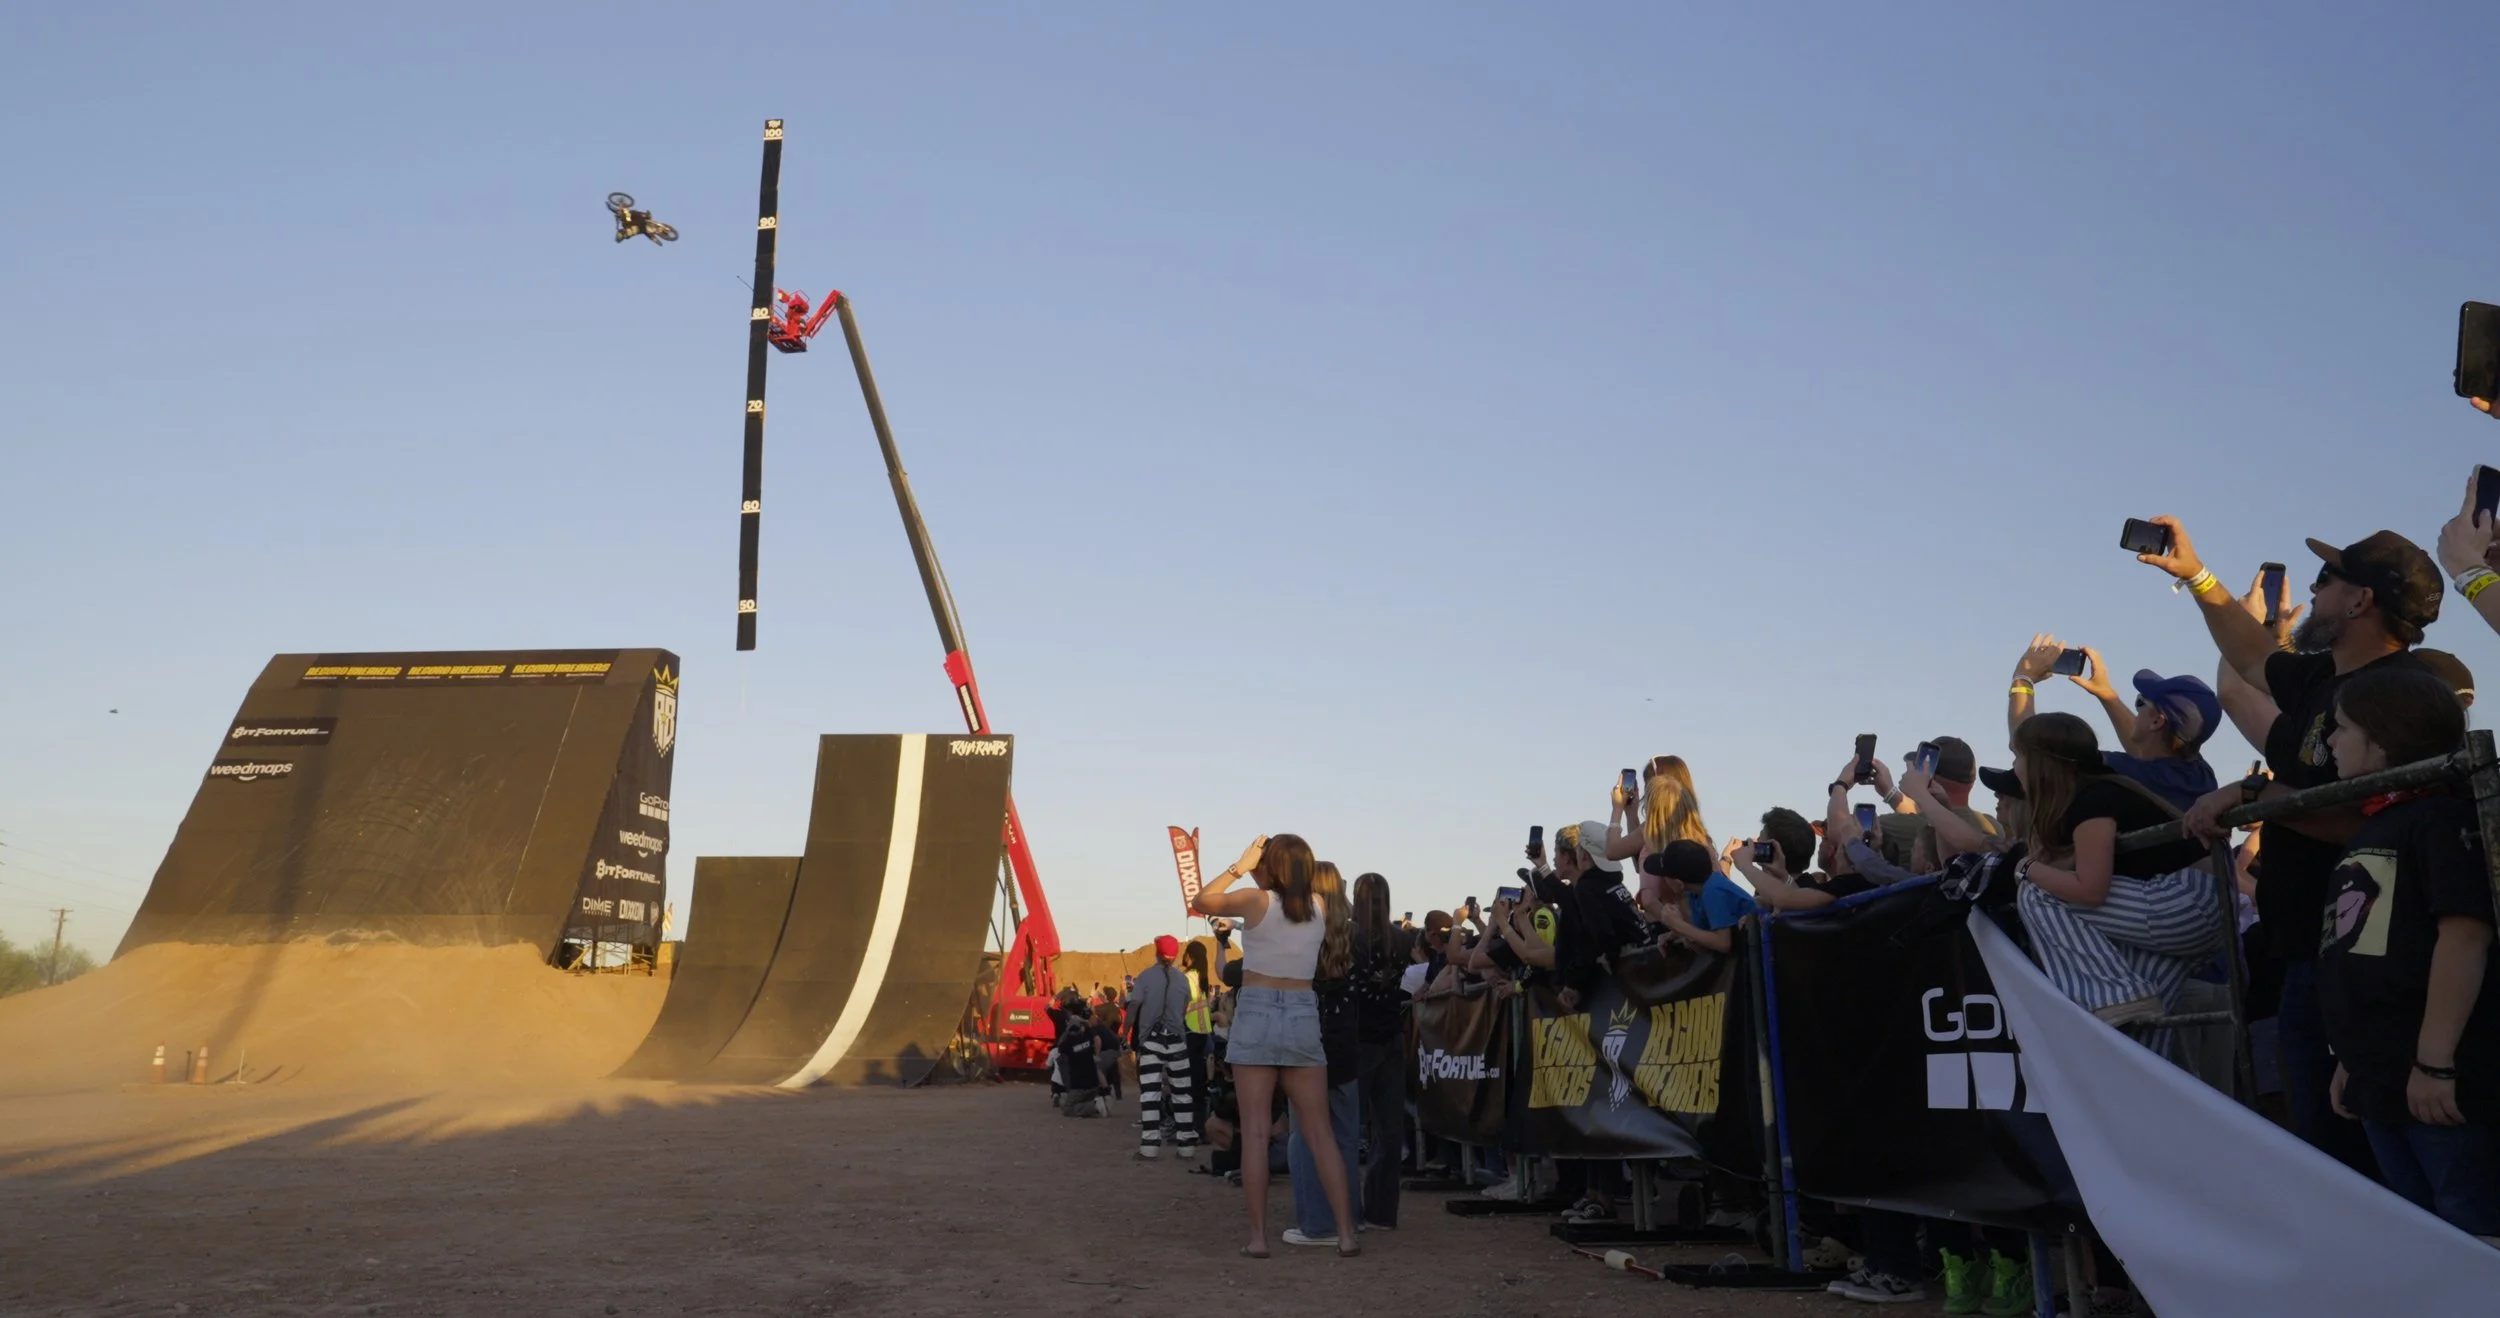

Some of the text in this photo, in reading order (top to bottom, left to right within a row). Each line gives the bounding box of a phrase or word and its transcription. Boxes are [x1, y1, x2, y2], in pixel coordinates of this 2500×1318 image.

[765, 128, 783, 138] 100
[760, 216, 776, 227] 90
[752, 307, 769, 317] 80
[747, 399, 763, 410] 70
[743, 500, 760, 511] 60
[740, 599, 755, 610] 50
[232, 726, 329, 739] BITFORTUNE
[974, 740, 1009, 756] RAMPS
[211, 762, 293, 775] weedmaps
[640, 792, 668, 809] GoPro
[619, 830, 663, 854] weedmaps
[596, 859, 661, 885] BITFORTUNE
[1638, 992, 1726, 1065] RECORD
